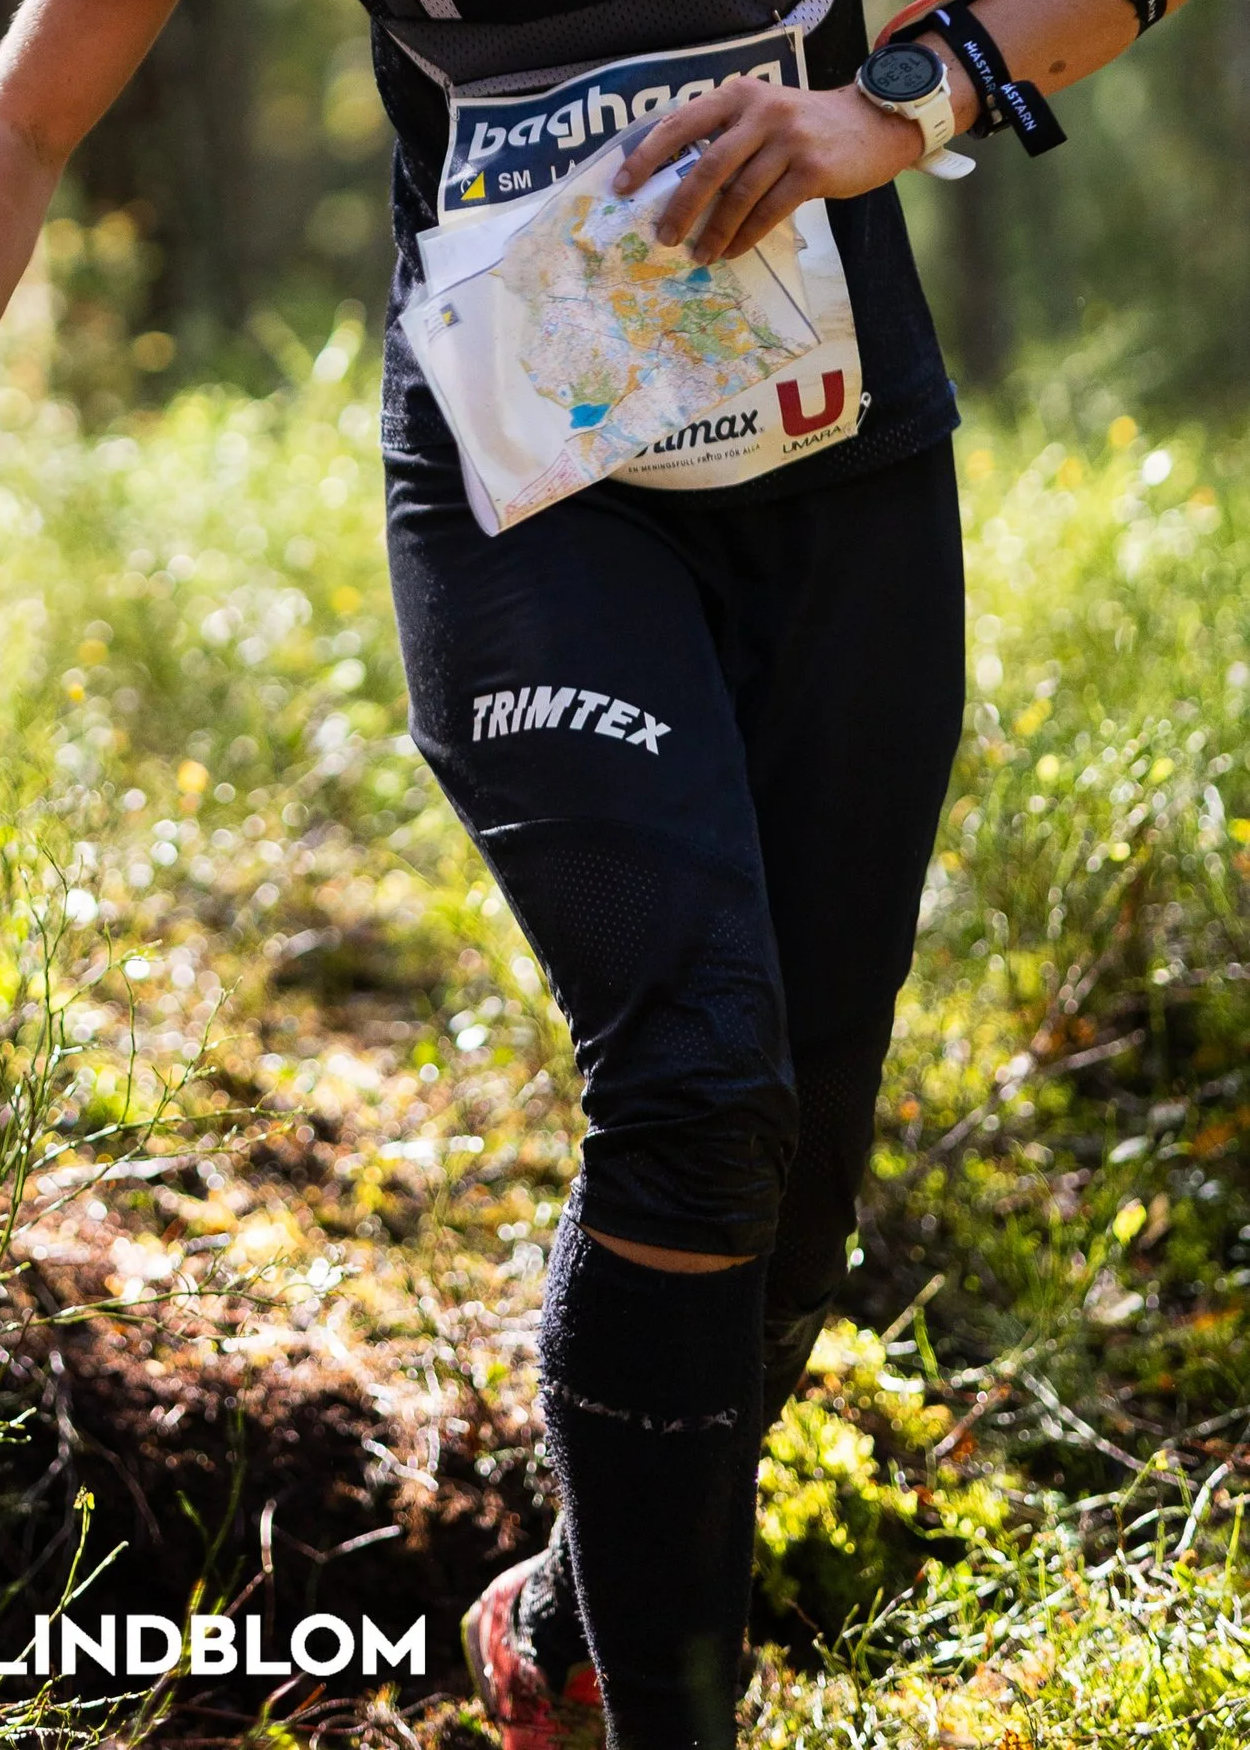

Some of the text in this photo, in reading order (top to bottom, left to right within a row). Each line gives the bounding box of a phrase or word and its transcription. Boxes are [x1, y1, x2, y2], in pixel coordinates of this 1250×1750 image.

[498, 169, 532, 192] SM
[782, 425, 842, 454] UMARA
[641, 458, 694, 473] MENINGSFULL
[743, 443, 761, 456] ALLA
[472, 685, 672, 755] TRIMTEX
